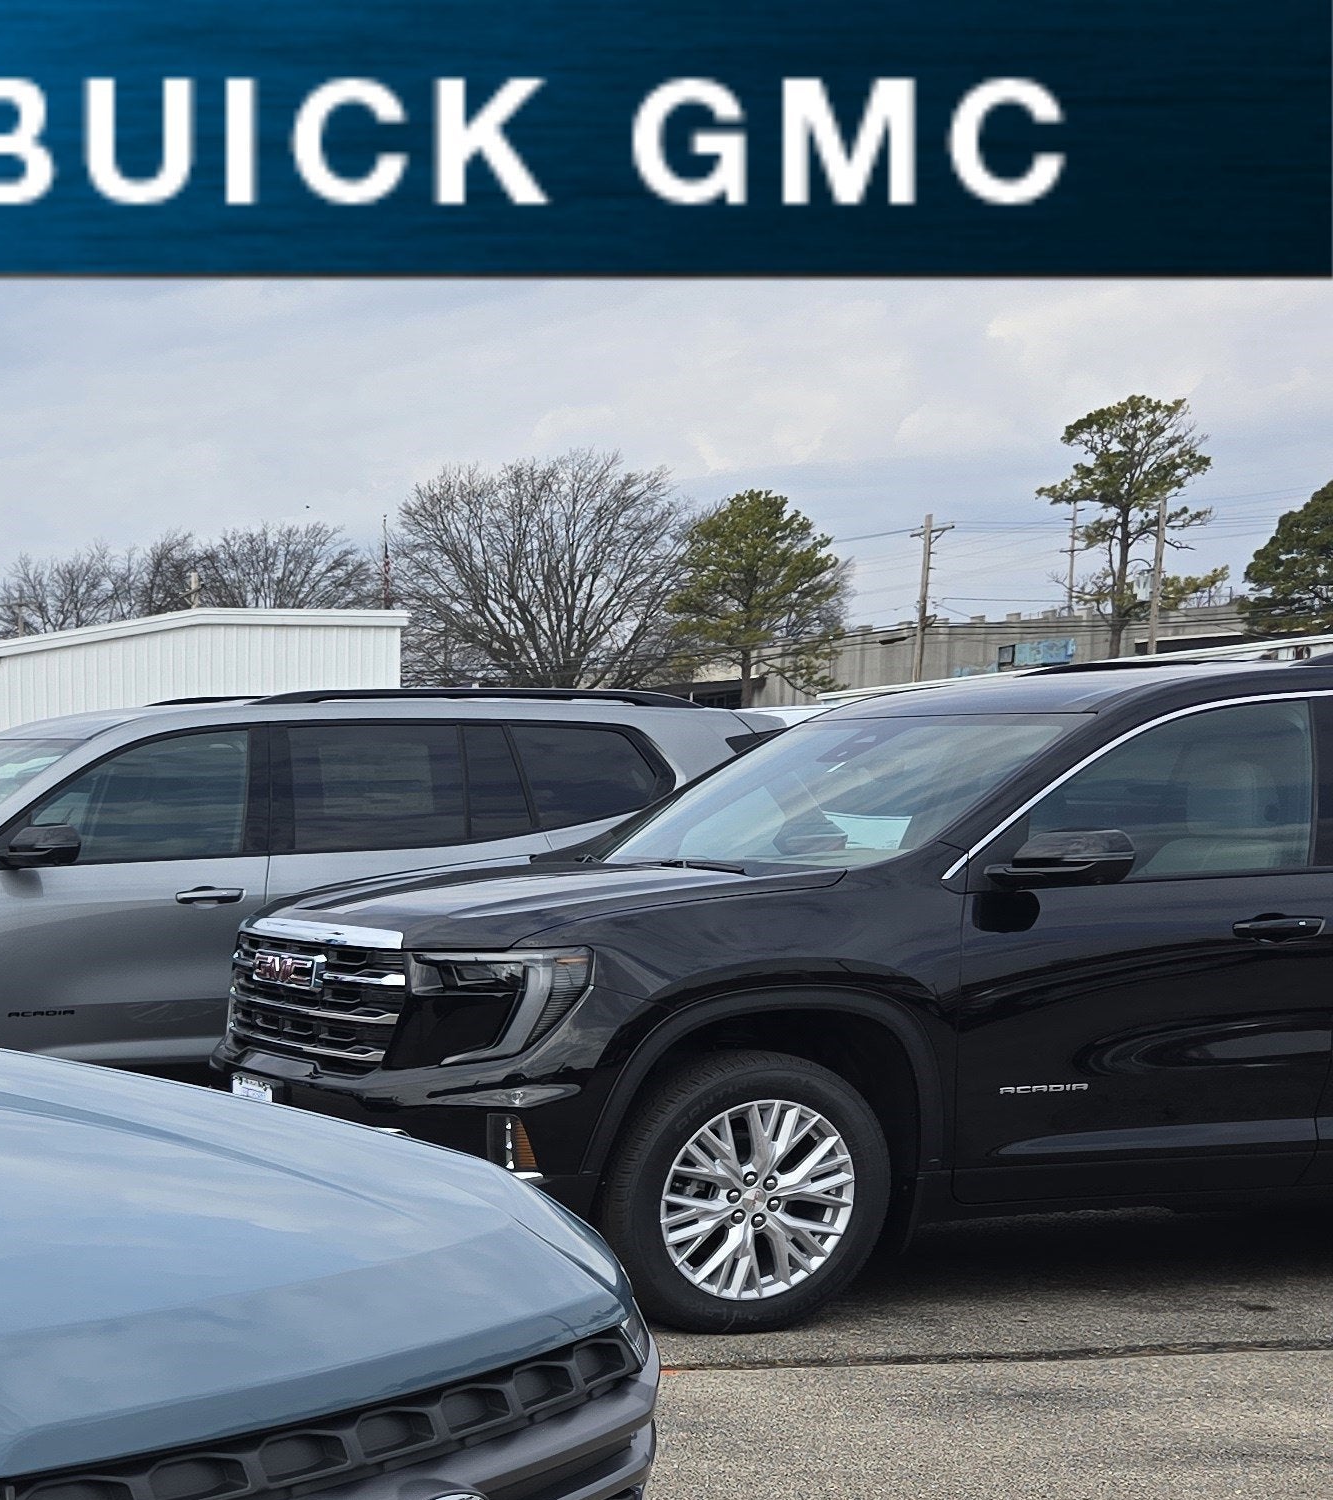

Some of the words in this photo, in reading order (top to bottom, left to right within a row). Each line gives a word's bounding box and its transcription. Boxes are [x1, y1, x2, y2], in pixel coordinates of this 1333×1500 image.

[253, 952, 313, 987] GMC
[7, 1009, 75, 1018] ACADIA
[999, 1083, 1089, 1095] ACADIA
